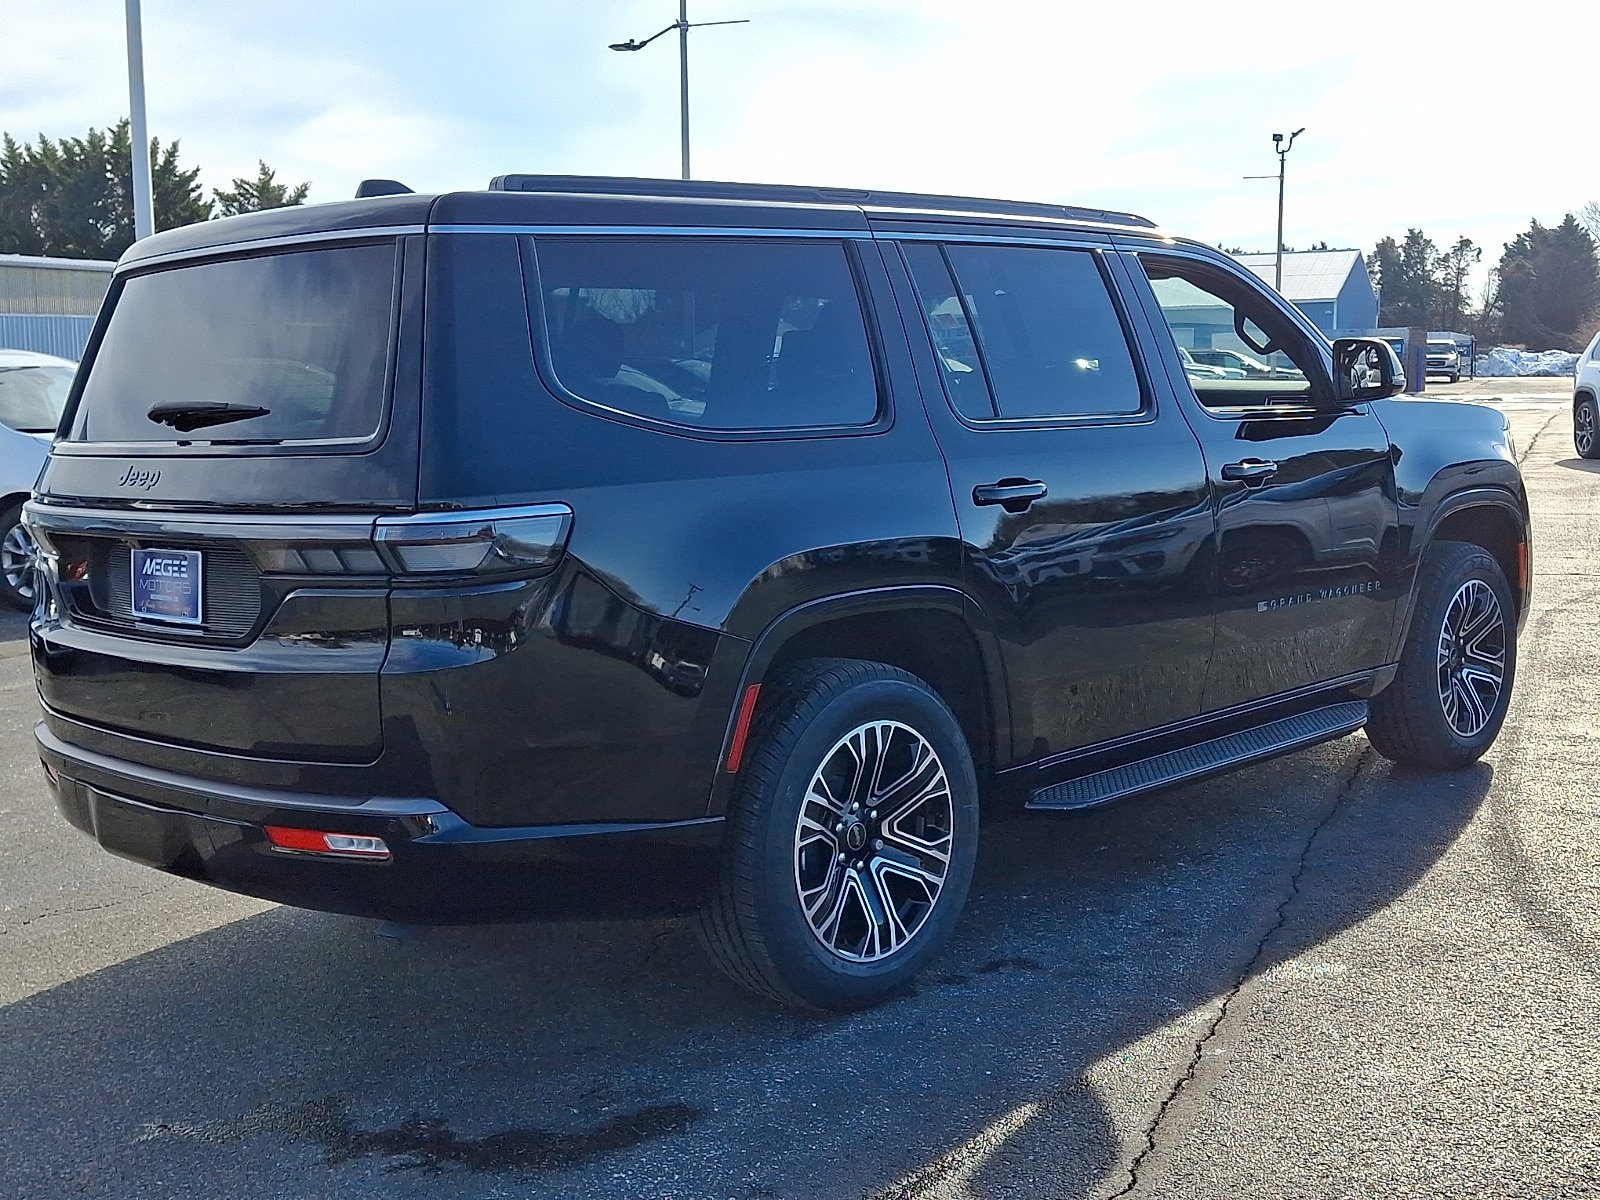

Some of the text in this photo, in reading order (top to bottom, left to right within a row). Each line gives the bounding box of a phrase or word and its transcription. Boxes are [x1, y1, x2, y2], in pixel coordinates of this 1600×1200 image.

[119, 465, 162, 491] Jeep
[142, 558, 188, 578] MEGEE
[139, 579, 191, 595] MOTORS
[1271, 580, 1381, 610] GRAND WAGONEER
